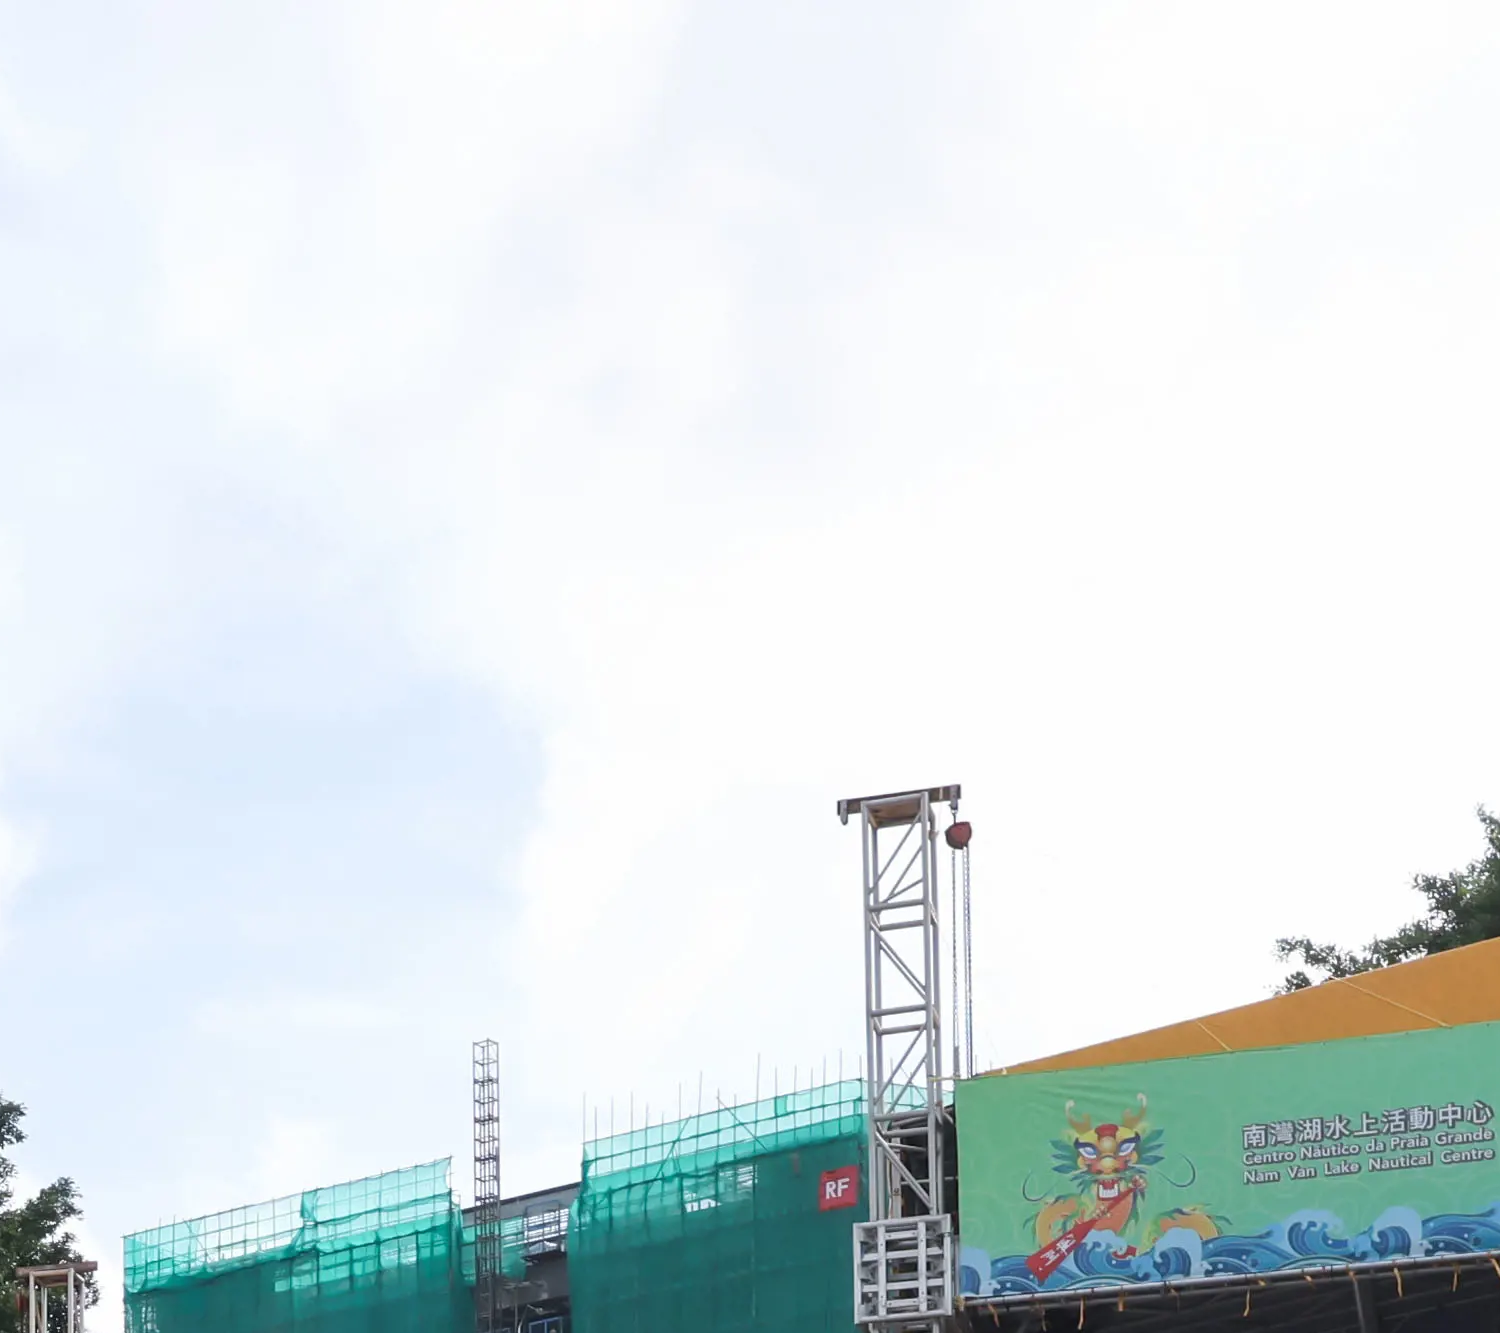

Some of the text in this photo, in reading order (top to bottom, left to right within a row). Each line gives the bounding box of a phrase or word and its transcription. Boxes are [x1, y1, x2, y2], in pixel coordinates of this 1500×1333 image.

[1242, 1100, 1494, 1149] 南灣湖水上活動中心
[1243, 1127, 1495, 1166] Centro Náutico da Praia Grande
[1243, 1147, 1495, 1185] Nam Van Lake Nautical Centre
[825, 1177, 850, 1200] RF
